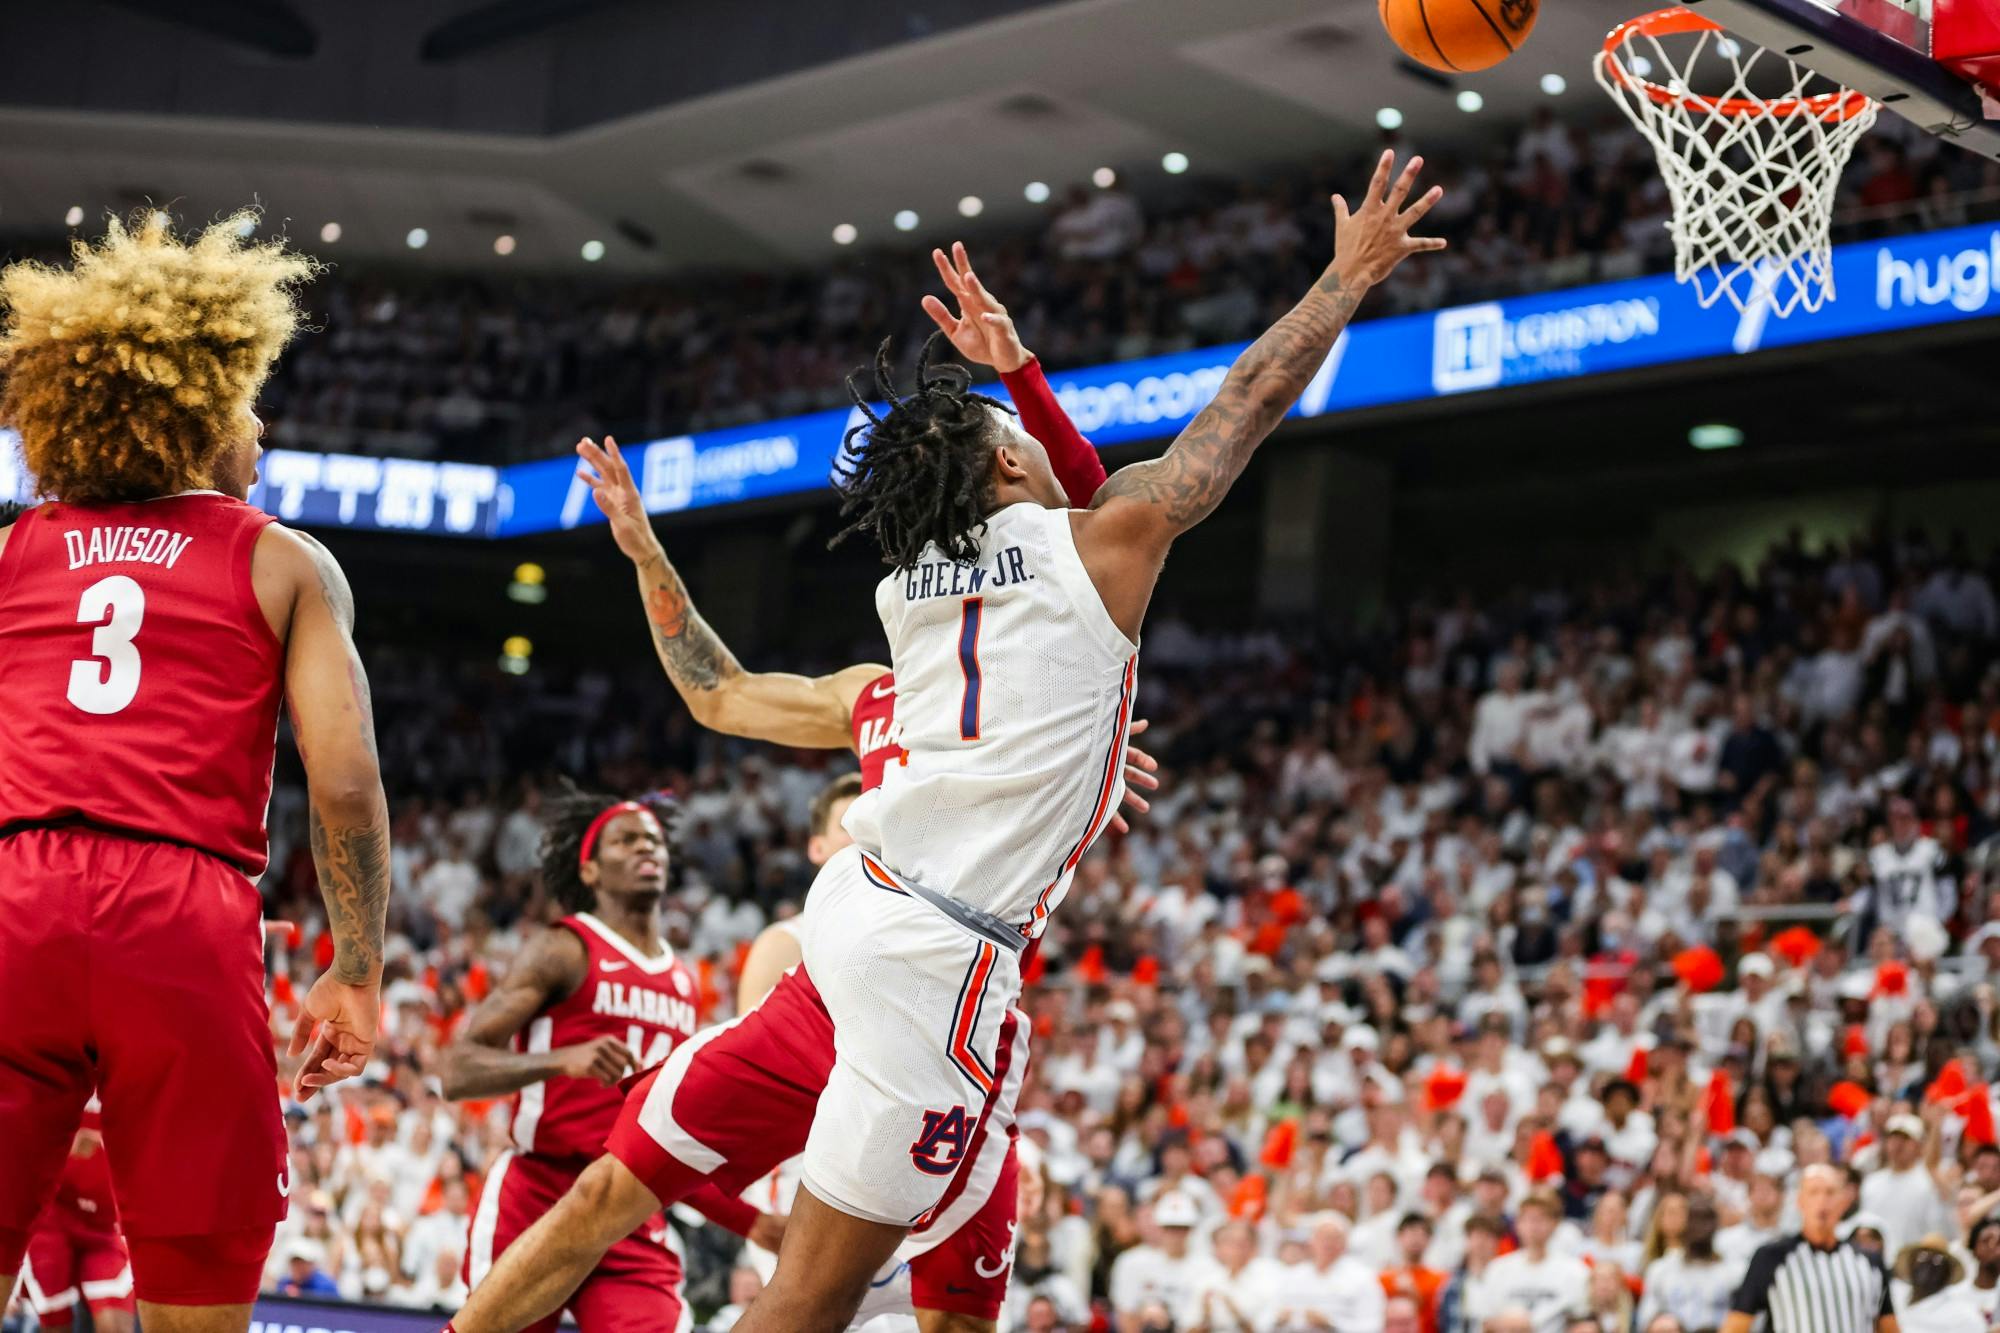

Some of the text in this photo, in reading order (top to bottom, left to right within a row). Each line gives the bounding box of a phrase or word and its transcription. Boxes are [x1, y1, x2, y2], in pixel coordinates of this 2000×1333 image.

[64, 526, 193, 570] DAVISON
[906, 546, 1035, 601] GREEN JR.
[66, 575, 145, 715] 3
[958, 597, 983, 741] 1
[592, 980, 696, 1037] ALABAMA
